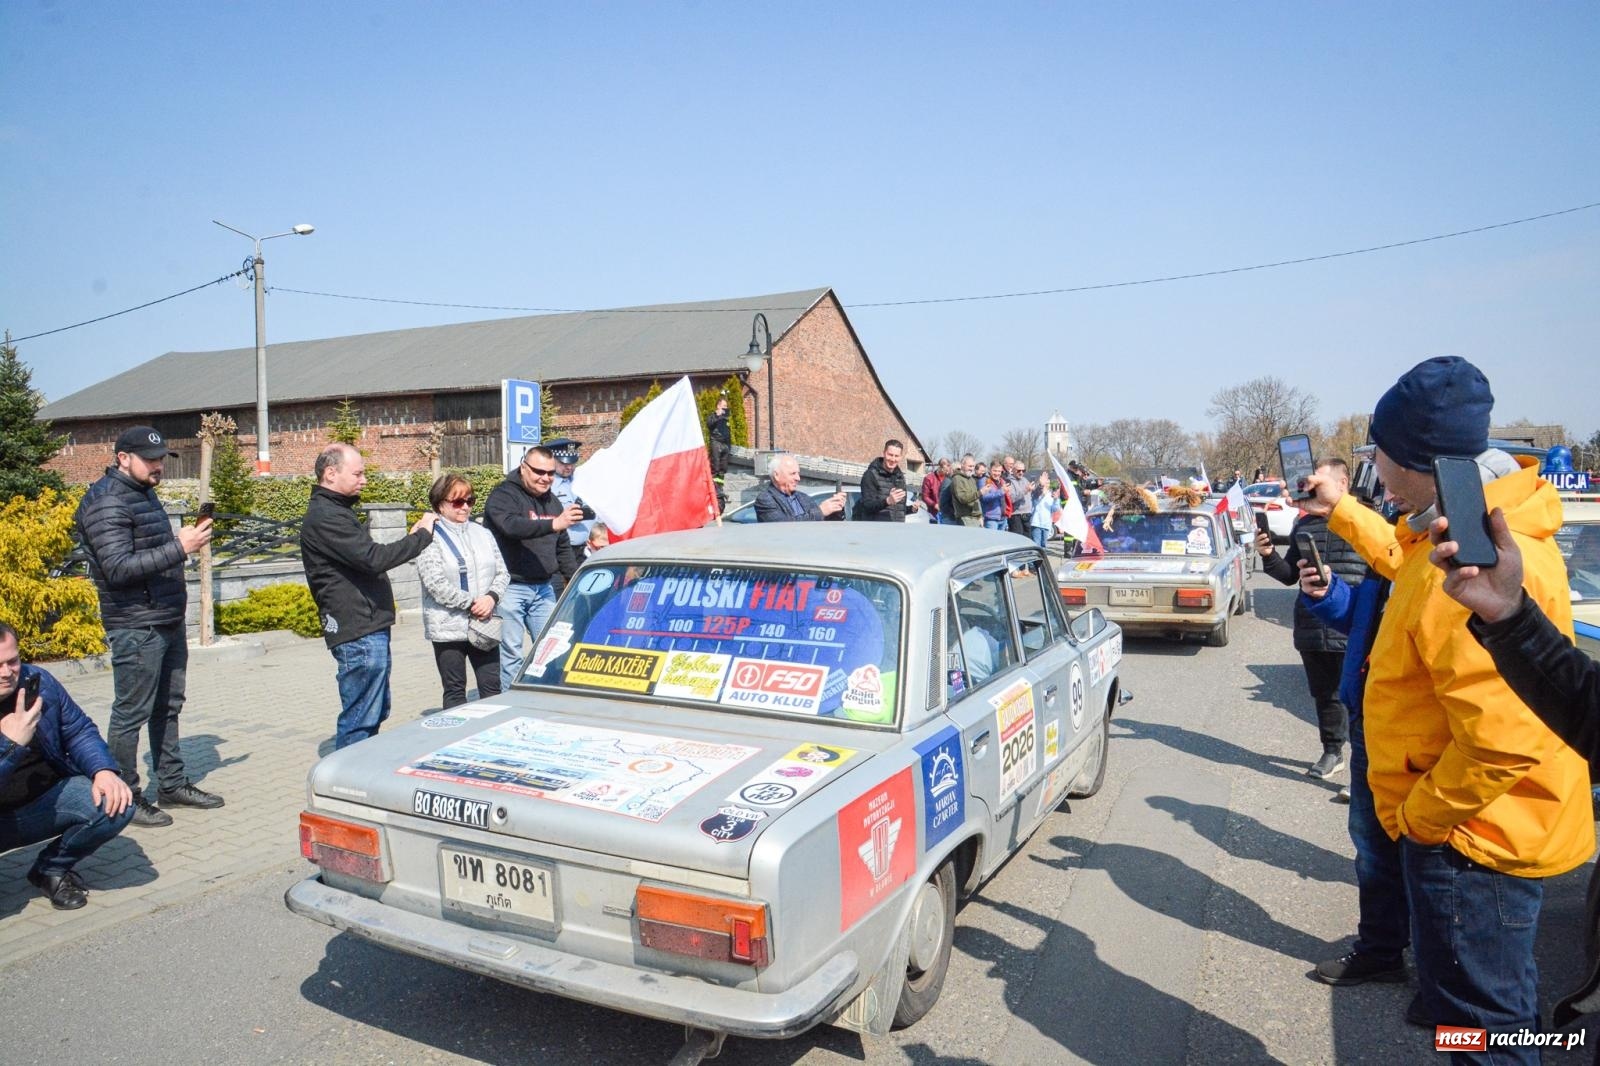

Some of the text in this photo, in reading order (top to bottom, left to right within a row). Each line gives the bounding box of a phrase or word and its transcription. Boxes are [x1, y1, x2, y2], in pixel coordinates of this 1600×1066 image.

[515, 386, 534, 424] P
[1540, 473, 1588, 489] ILICJA
[656, 576, 749, 608] POLSKI
[750, 579, 816, 612] FIAT
[815, 607, 846, 620] FSO
[626, 616, 836, 641] 80 100 125P 140 160
[575, 652, 604, 672] Radio
[764, 669, 820, 692] FSO
[729, 690, 815, 709] AUTO KLUB
[1072, 678, 1083, 716] 99
[1002, 723, 1034, 775] 2026
[432, 796, 462, 822] 8081
[463, 802, 488, 826] PKT
[711, 828, 734, 839] CITY
[721, 820, 738, 832] 3
[495, 862, 547, 898] 8081
